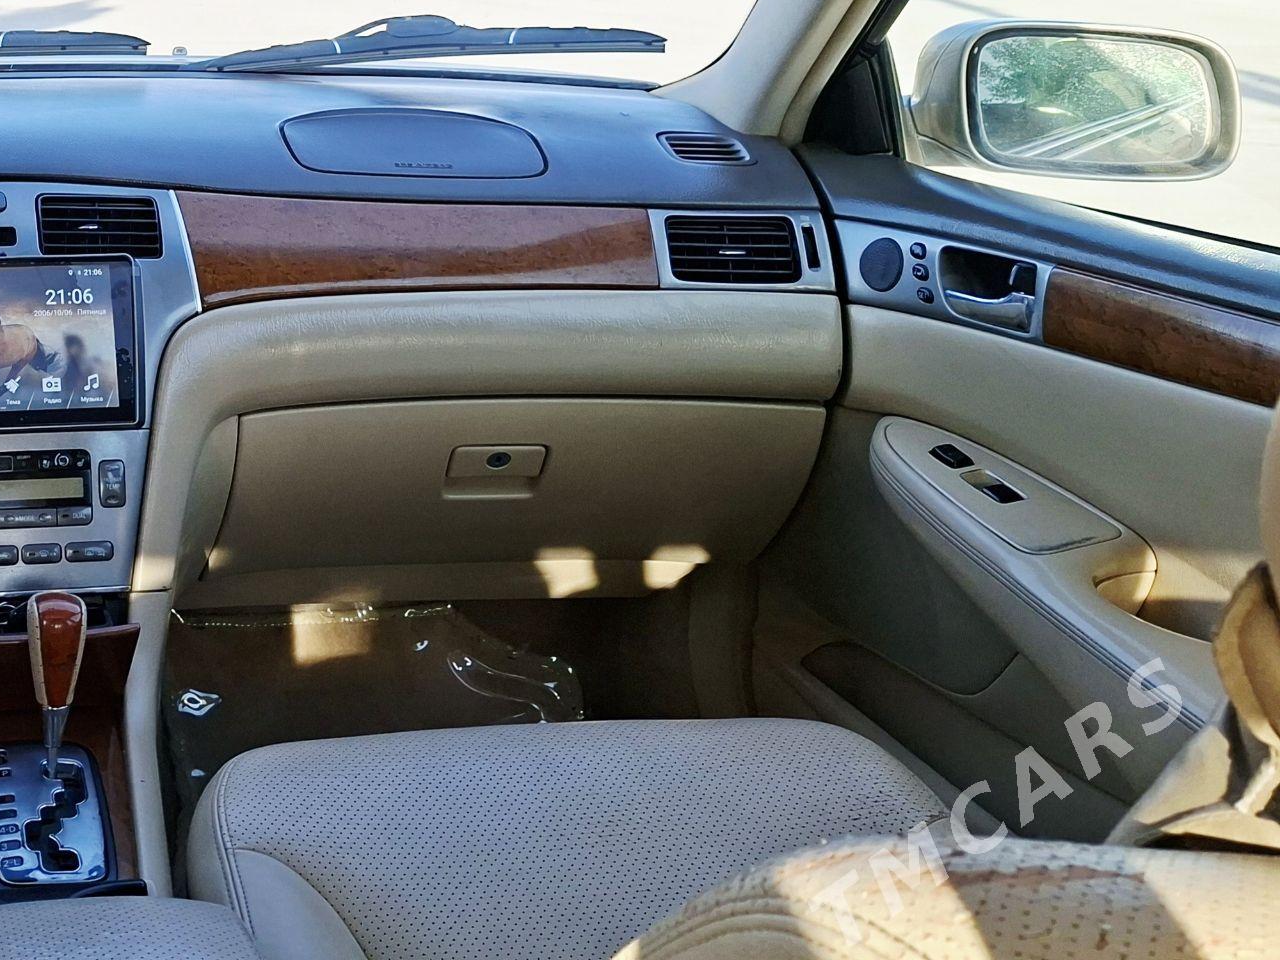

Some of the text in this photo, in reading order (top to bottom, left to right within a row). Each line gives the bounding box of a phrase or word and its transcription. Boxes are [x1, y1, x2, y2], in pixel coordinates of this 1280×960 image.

[83, 268, 103, 276] 21:06
[45, 288, 94, 305] 21:06
[33, 308, 107, 317] 2006/10/06 Пятница
[0, 825, 16, 833] 4-D
[1, 843, 8, 851] 3
[2, 857, 20, 867] 2-L
